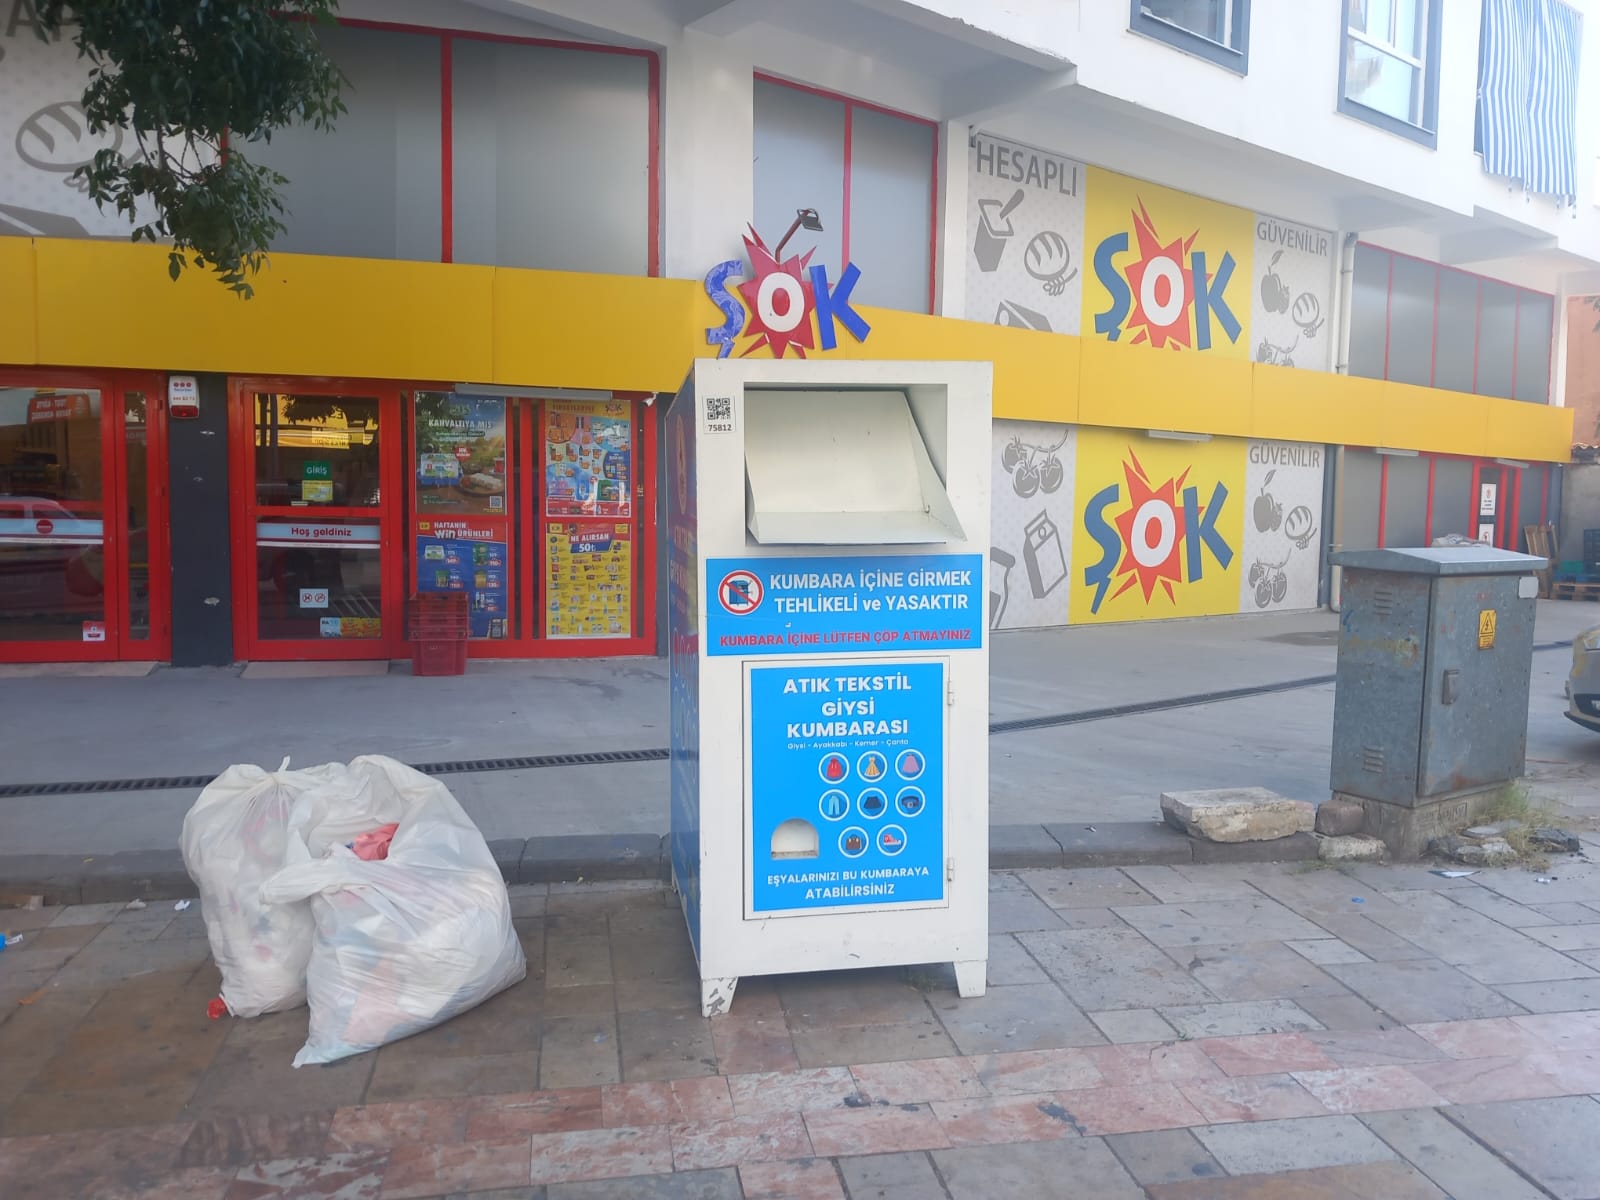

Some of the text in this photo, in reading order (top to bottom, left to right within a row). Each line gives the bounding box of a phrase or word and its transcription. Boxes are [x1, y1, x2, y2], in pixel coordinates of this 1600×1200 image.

[976, 140, 1077, 196] HESAPLI
[1257, 221, 1328, 257] GÜVENİLİR
[1093, 231, 1243, 351] ŞOK
[704, 260, 871, 360] ŞOK
[1249, 442, 1321, 469] GÜVENİLİR
[306, 465, 328, 475] GİRİŞ
[291, 527, 352, 537] Hoş geldiniz
[581, 533, 609, 541] ALIRSAN
[1084, 481, 1234, 615] ŞOK
[770, 569, 972, 592] KUMBARA İÇİNE GİRMEK
[774, 594, 969, 613] TEHLİKELİ ve YASAKTIR
[719, 629, 972, 647] KUMBARA İÇİNE LÜTFEN ÇÖP ATMAYINIZ
[783, 672, 912, 694] ATIK TEKSTİL
[821, 697, 875, 717] GİYSİ
[787, 719, 908, 738] KUMBARASI
[767, 867, 929, 887] EŞYALARINIZI BU KUMBARAYA
[805, 884, 895, 900] ATABİLİRSİNİZ
